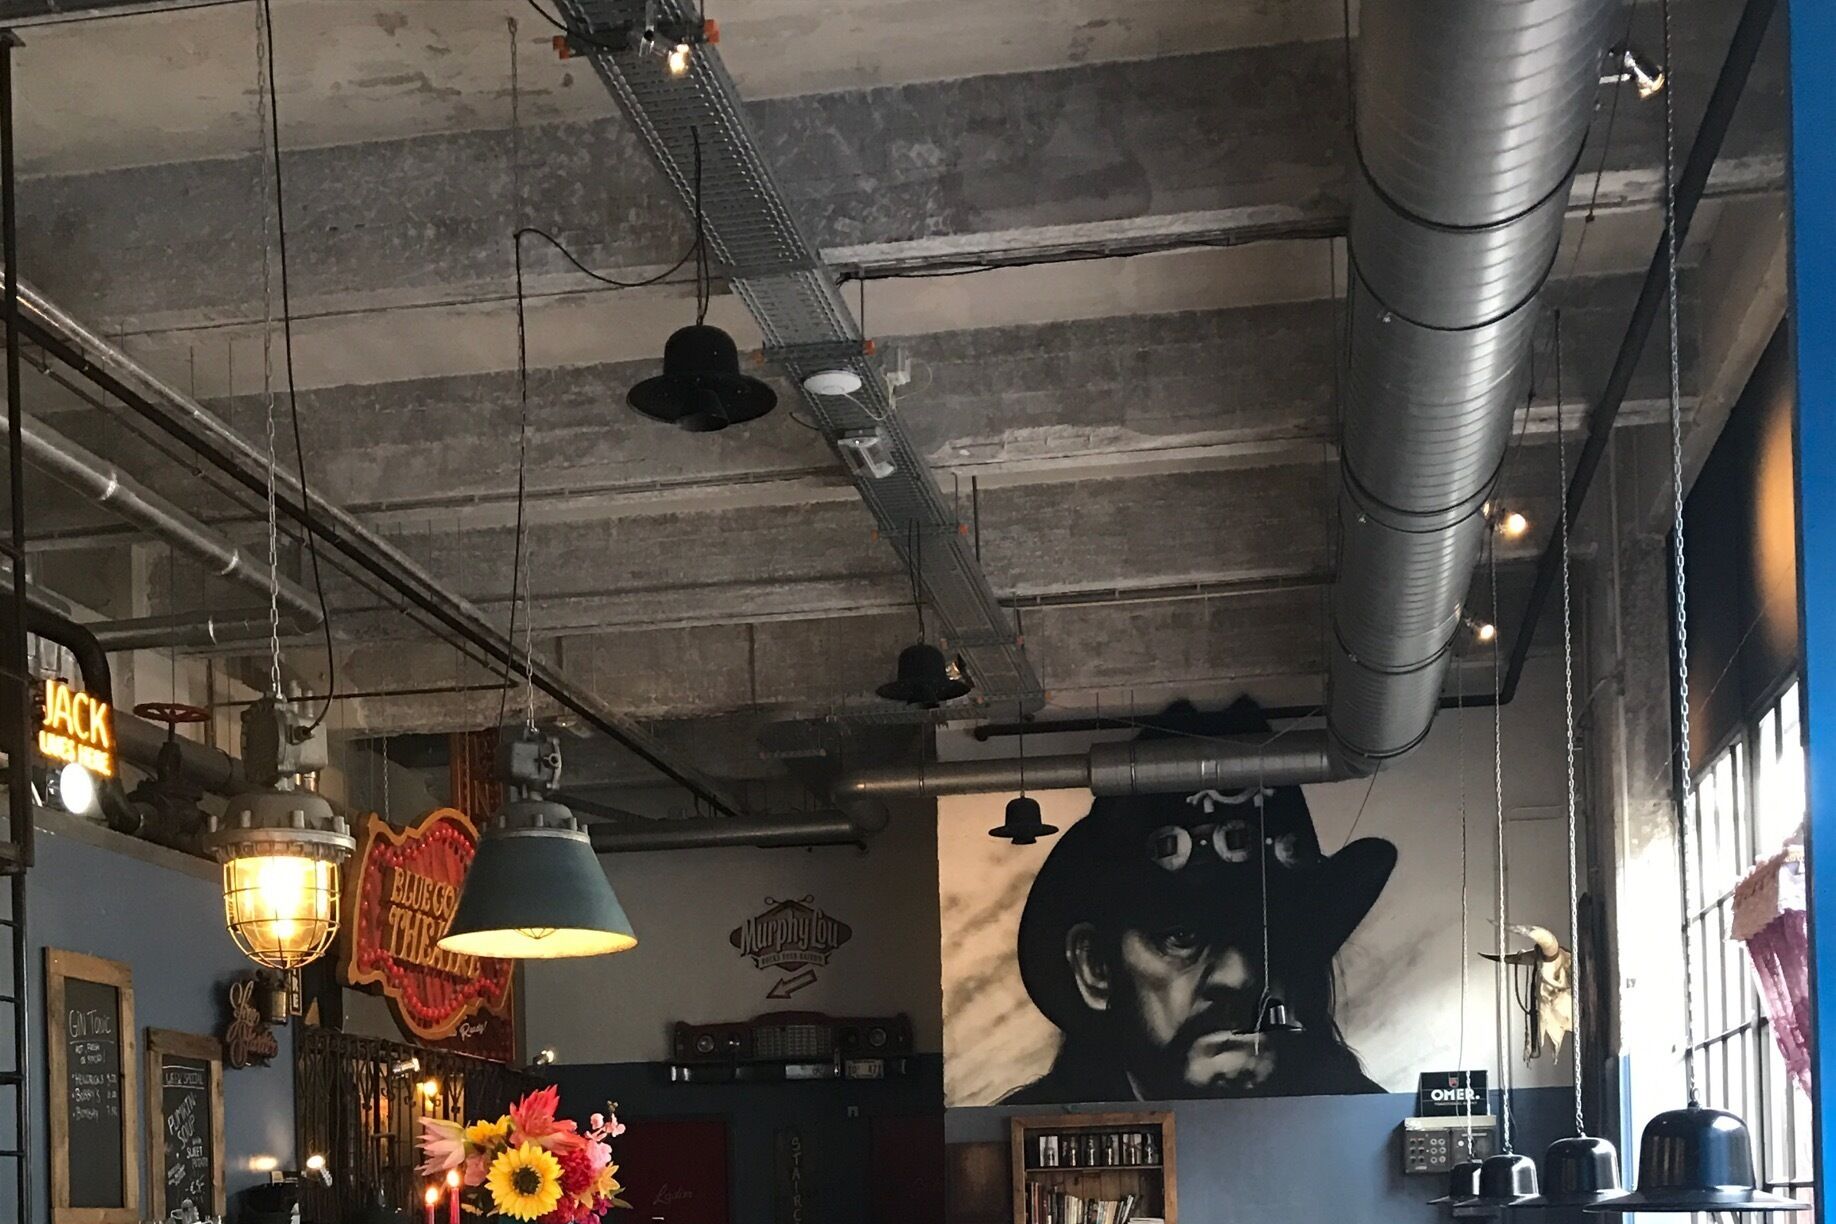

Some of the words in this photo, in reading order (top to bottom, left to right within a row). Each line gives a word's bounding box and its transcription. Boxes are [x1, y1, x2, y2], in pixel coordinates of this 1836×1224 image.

[42, 679, 110, 749] JACK
[390, 866, 433, 912] BLUE
[740, 906, 810, 957] Murphy
[1431, 1088, 1481, 1101] OMER.
